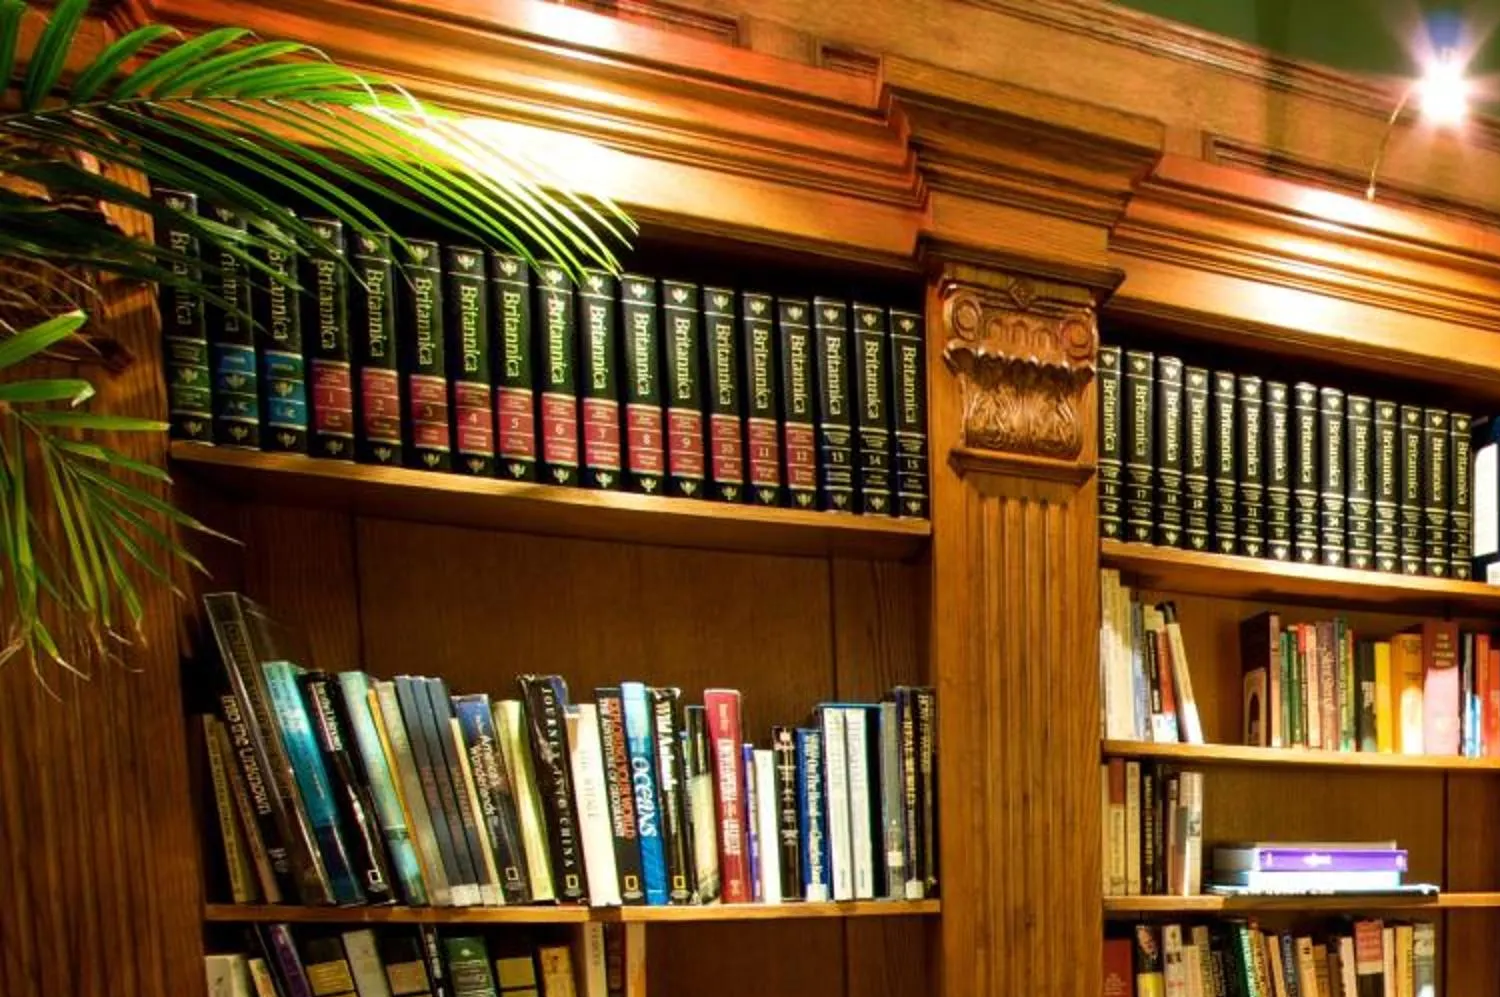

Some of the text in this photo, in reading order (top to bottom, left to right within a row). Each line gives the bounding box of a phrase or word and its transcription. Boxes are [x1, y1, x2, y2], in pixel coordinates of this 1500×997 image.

[317, 258, 339, 349] Britannica
[367, 268, 387, 357] Britannica
[415, 277, 437, 365] Britannica
[460, 284, 481, 372] Britannica
[503, 291, 525, 378] Britannica
[548, 298, 571, 384] Britannica
[589, 305, 609, 389] Britannica
[633, 312, 653, 396] Britannica
[674, 317, 694, 400] Britannica
[715, 324, 734, 405] Britannica
[752, 329, 771, 409] Britannica
[790, 335, 808, 414] Britannica
[826, 336, 845, 415] Britannica
[864, 341, 882, 420] Britannica
[902, 346, 919, 424] Britannica
[1103, 378, 1117, 451] Britannica
[1135, 384, 1149, 456] Britannica
[1166, 391, 1180, 461] Britannica
[1191, 398, 1206, 468] Britannica
[1220, 403, 1233, 472] Britannica
[1247, 407, 1260, 476] Britannica
[1274, 413, 1286, 481] Britannica
[1300, 416, 1314, 483] Britannica
[1328, 420, 1341, 487] Britannica
[232, 722, 251, 747] the
[601, 717, 616, 769] ADVENTURE
[655, 701, 672, 734] Wild
[237, 748, 272, 816] Unknown
[469, 744, 495, 816] Wonderlands
[481, 734, 502, 786] America's
[541, 686, 575, 868] JOURNEY INTO CHINA
[607, 696, 626, 761] EXPLORING
[618, 797, 634, 840] WORLD
